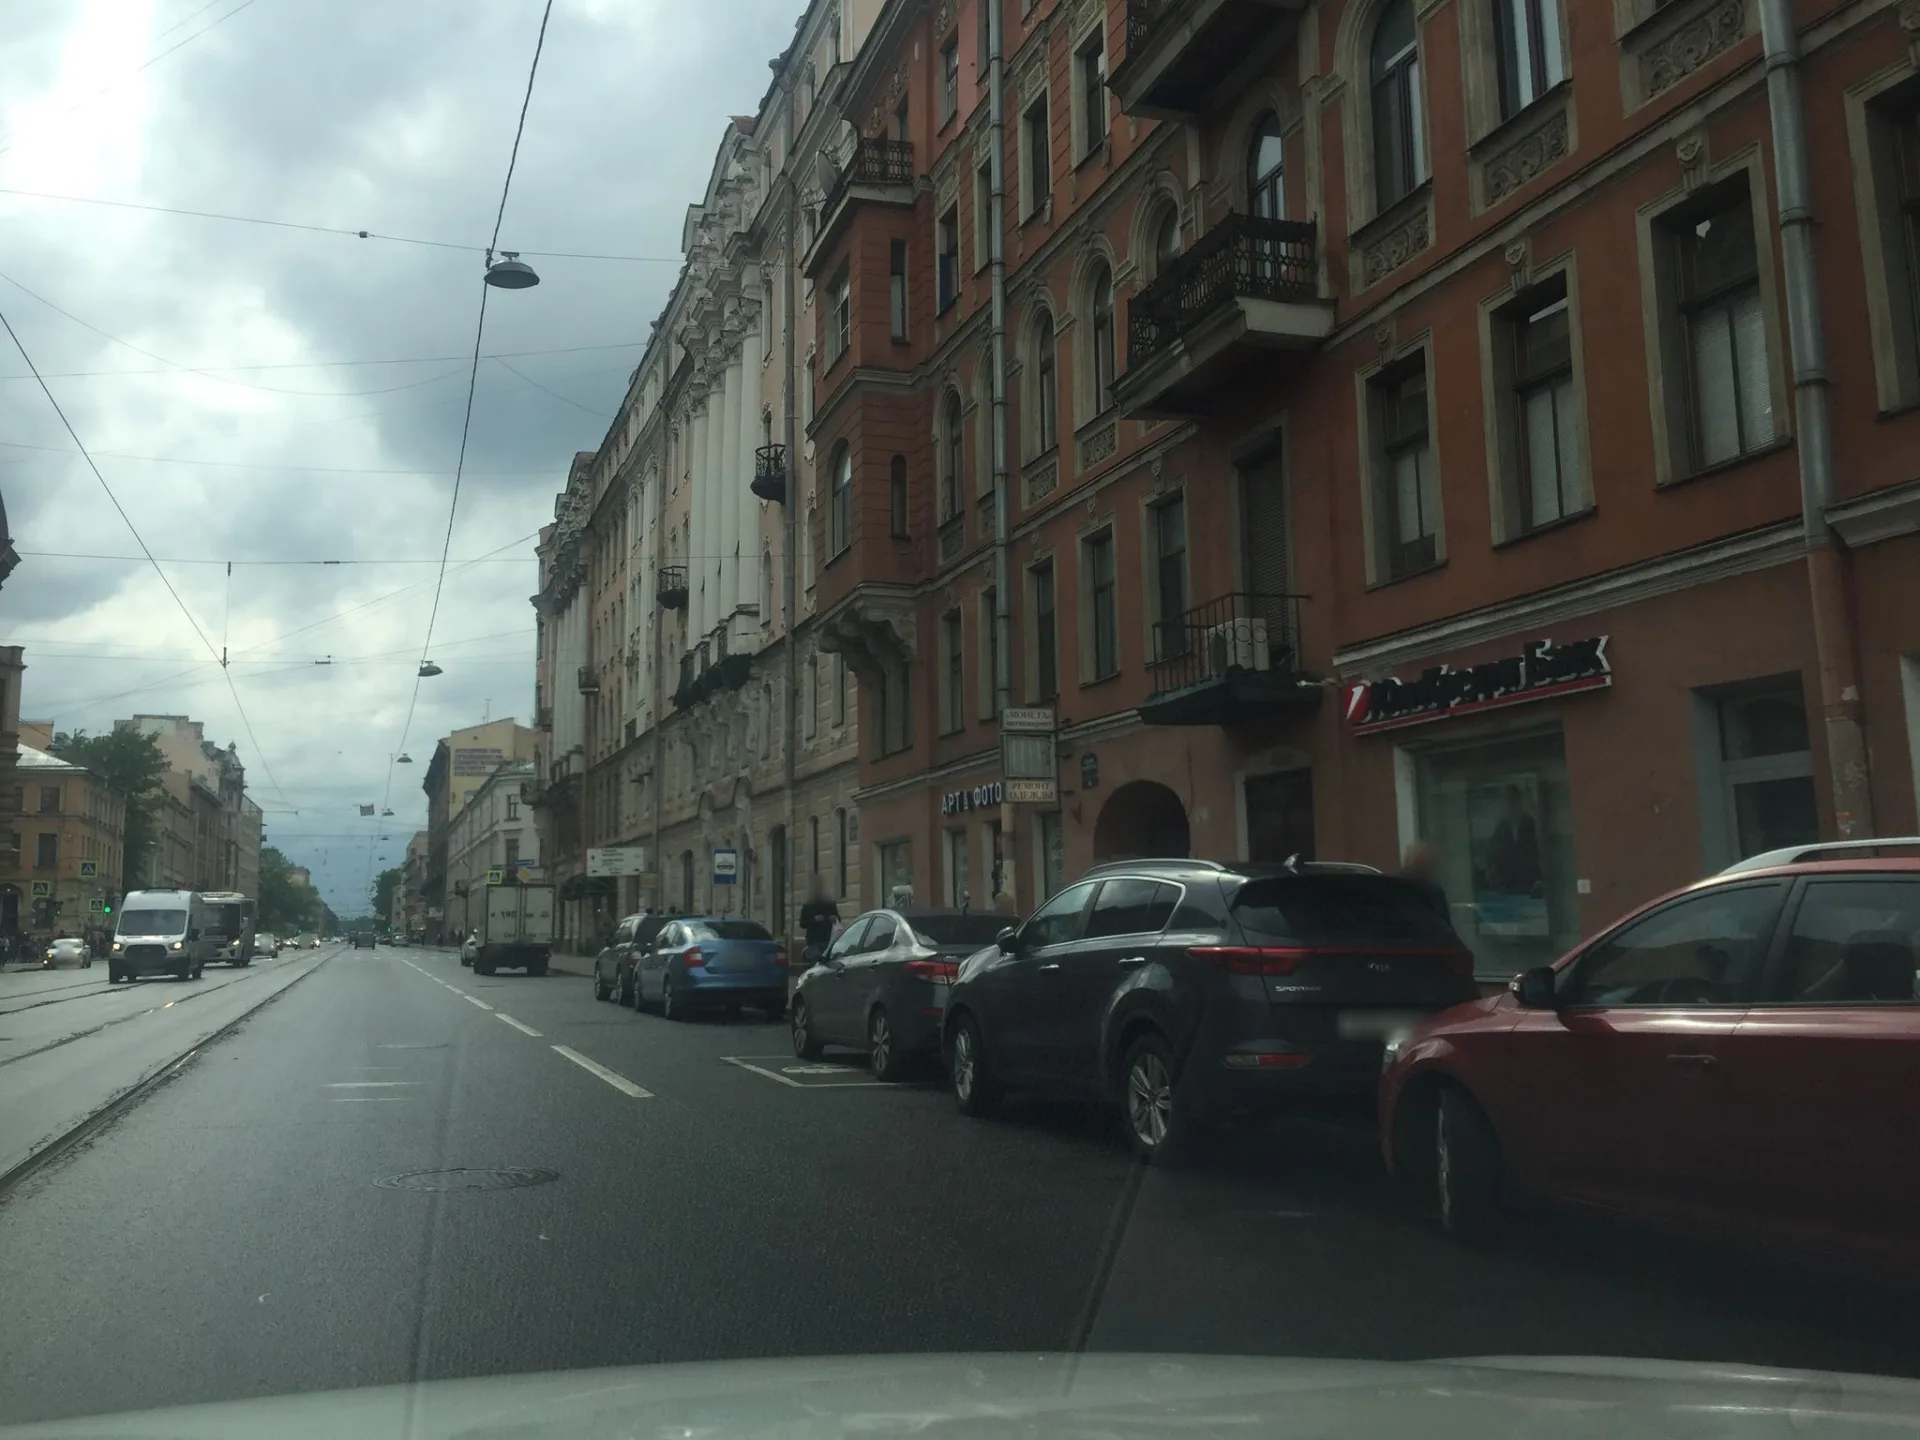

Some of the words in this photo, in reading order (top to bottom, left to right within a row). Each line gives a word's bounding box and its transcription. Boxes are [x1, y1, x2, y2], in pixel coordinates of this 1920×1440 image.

[1011, 782, 1050, 791] РЕМОНТ
[941, 791, 961, 814] АРТ
[973, 781, 1002, 806] ФОТО
[1009, 791, 1053, 800] ОДЕЖДЫ
